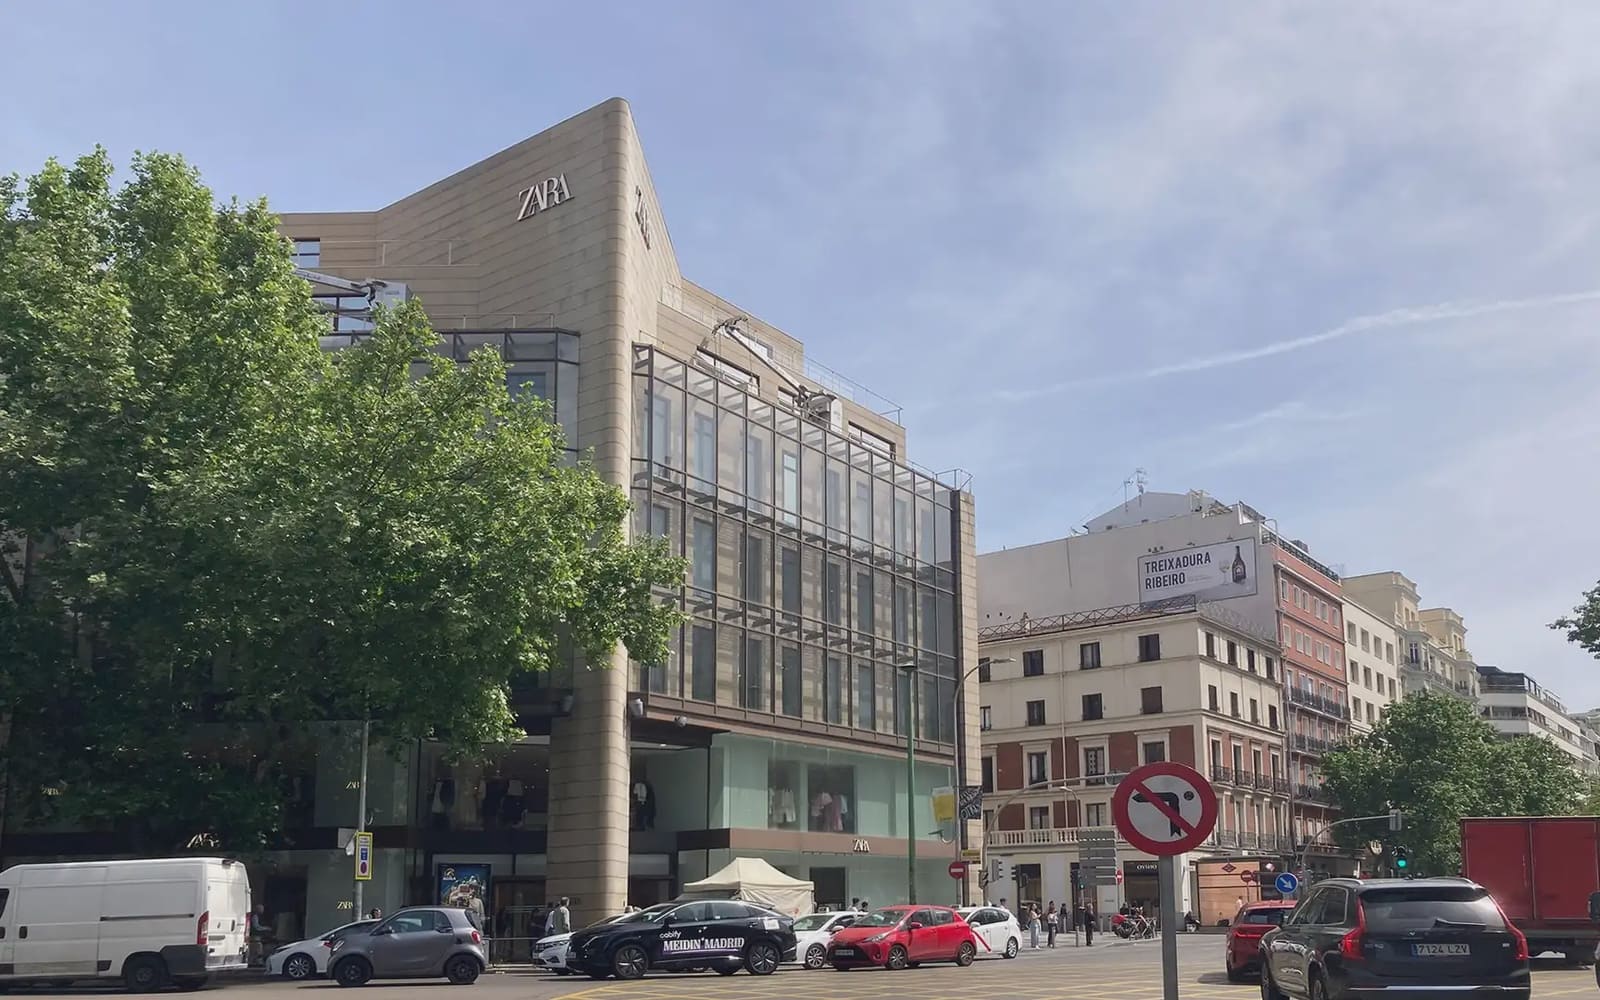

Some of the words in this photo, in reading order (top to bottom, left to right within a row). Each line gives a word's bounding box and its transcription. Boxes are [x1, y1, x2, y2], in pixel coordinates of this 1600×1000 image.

[517, 173, 575, 222] ZARA
[1144, 551, 1212, 574] TREIXADURA
[1145, 572, 1186, 590] RIBEIRO
[704, 937, 745, 949] MADRID
[1418, 944, 1444, 954] 7124
[1449, 944, 1468, 954] LZV
